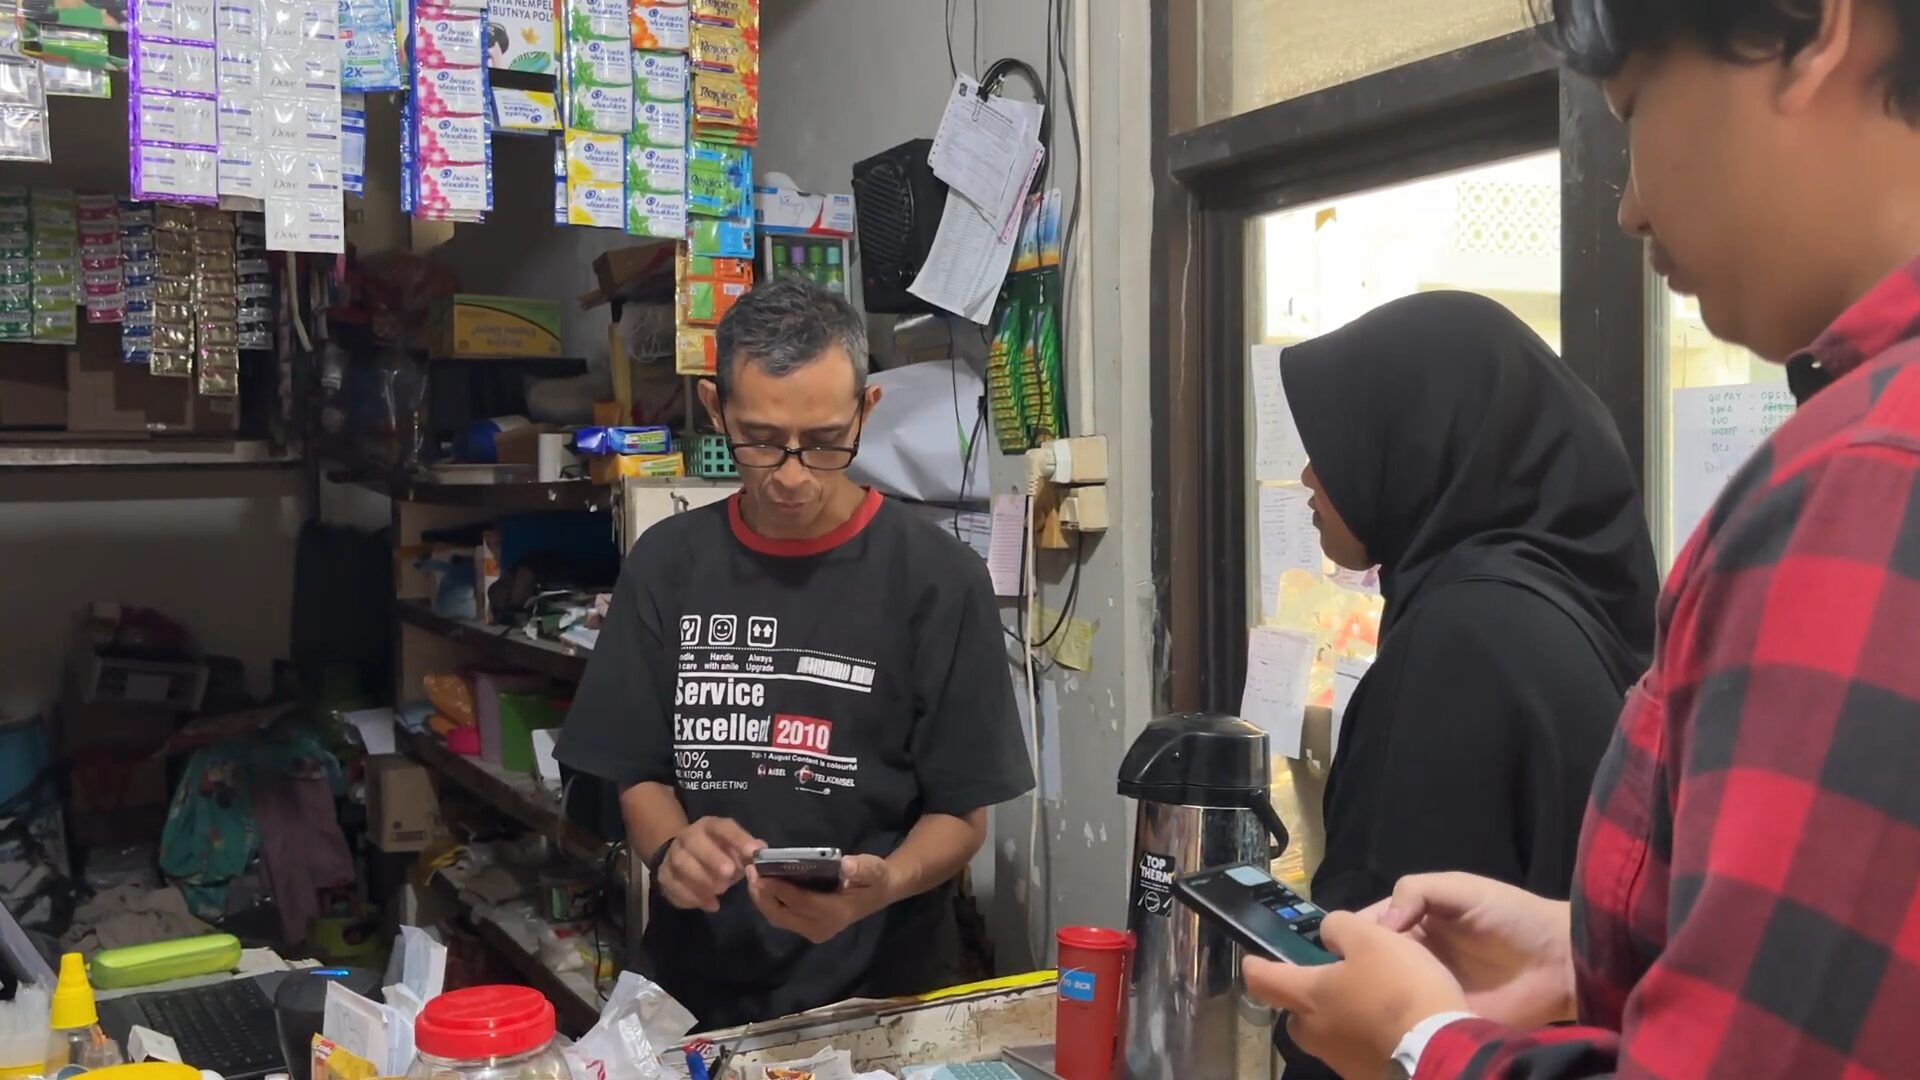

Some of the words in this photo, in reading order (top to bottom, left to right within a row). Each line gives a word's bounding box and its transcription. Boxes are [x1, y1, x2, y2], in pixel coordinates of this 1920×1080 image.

[270, 76, 296, 87] Dove
[700, 86, 737, 100] Rejoice
[272, 127, 298, 138] Dove
[272, 179, 299, 189] Dove
[710, 652, 734, 661] Handle
[748, 653, 773, 664] Always
[704, 662, 719, 670] with
[721, 662, 739, 671] smile
[745, 662, 774, 673] Upgrade
[674, 677, 765, 707] Service
[776, 719, 830, 750] 2010
[705, 770, 712, 779] &
[814, 773, 856, 787] TELKOMSEL
[701, 780, 748, 790] GREETING
[1146, 854, 1167, 870] TOP
[1140, 865, 1173, 885] THERM
